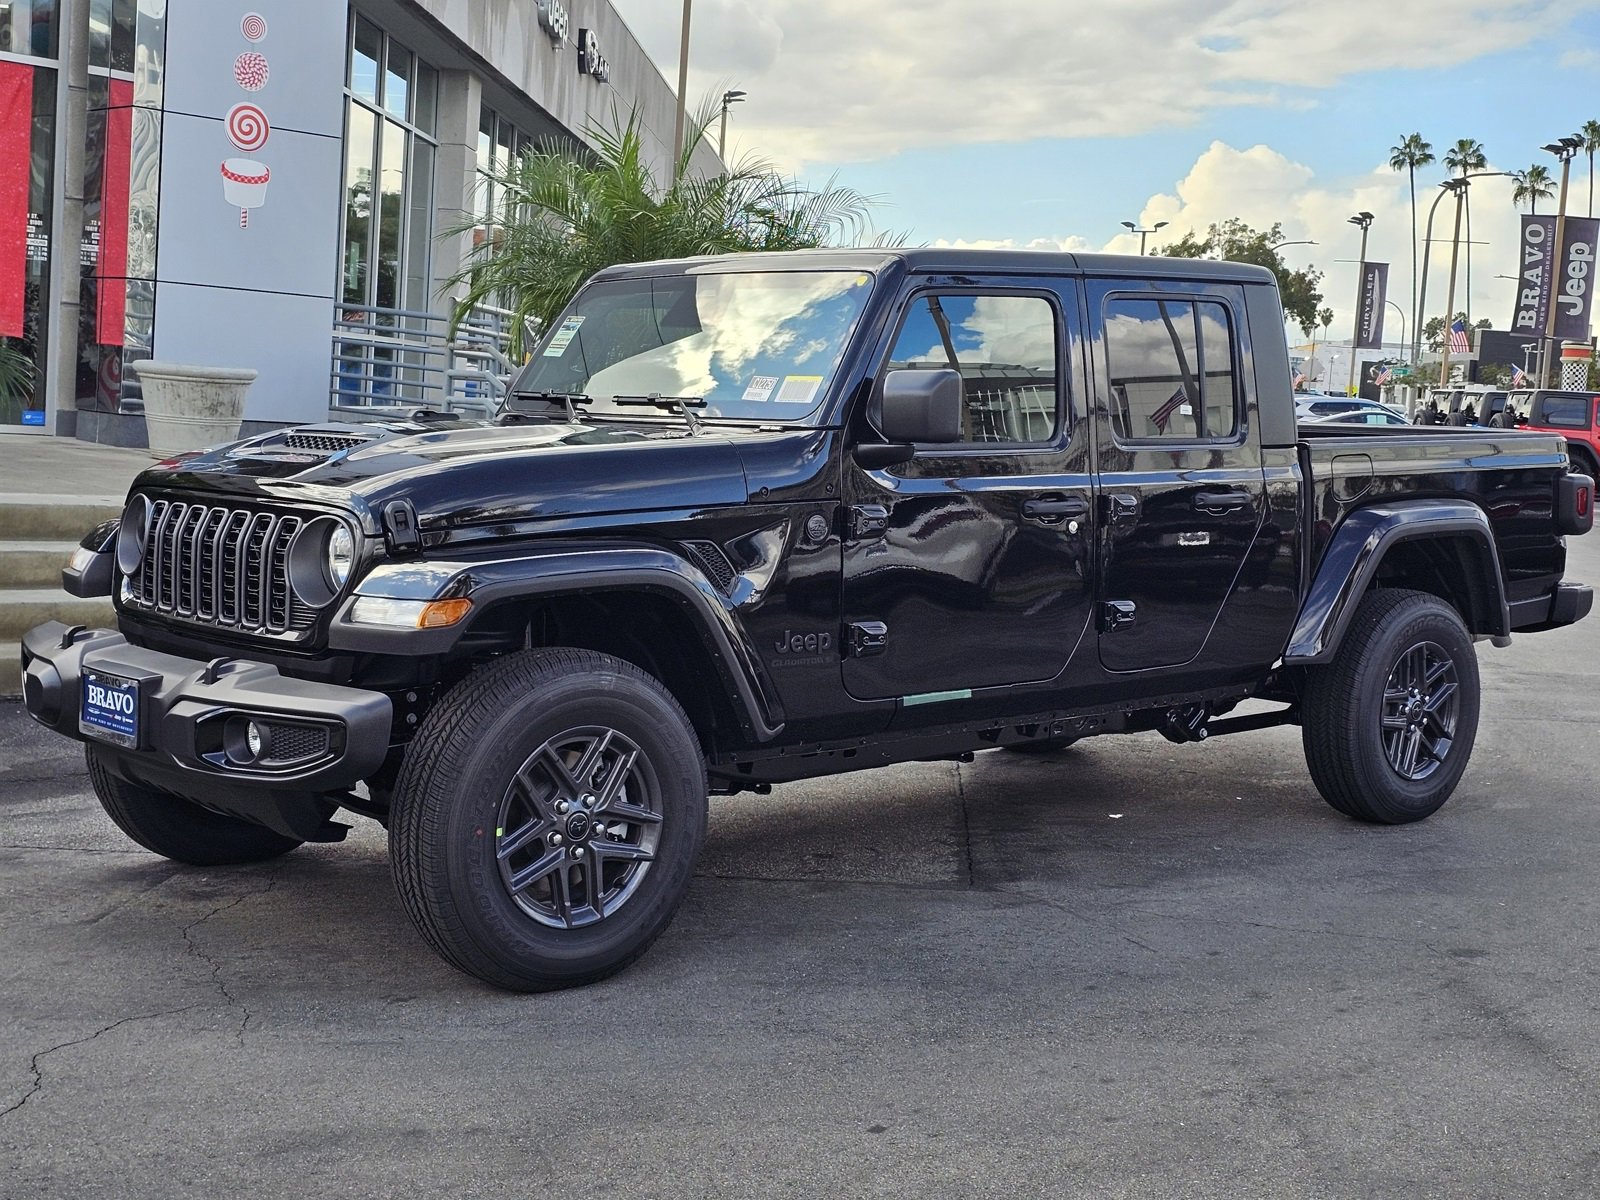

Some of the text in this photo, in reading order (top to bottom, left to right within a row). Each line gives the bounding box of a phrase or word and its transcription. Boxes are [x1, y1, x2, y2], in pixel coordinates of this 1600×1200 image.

[548, 0, 569, 49] Jeep
[1545, 224, 1553, 270] DEALERSHIP
[1517, 224, 1545, 329] BRAVO
[1558, 242, 1594, 316] Jeep
[1363, 273, 1374, 337] CHRYSLER
[775, 630, 831, 655] Jeep
[88, 685, 133, 714] BRAVO
